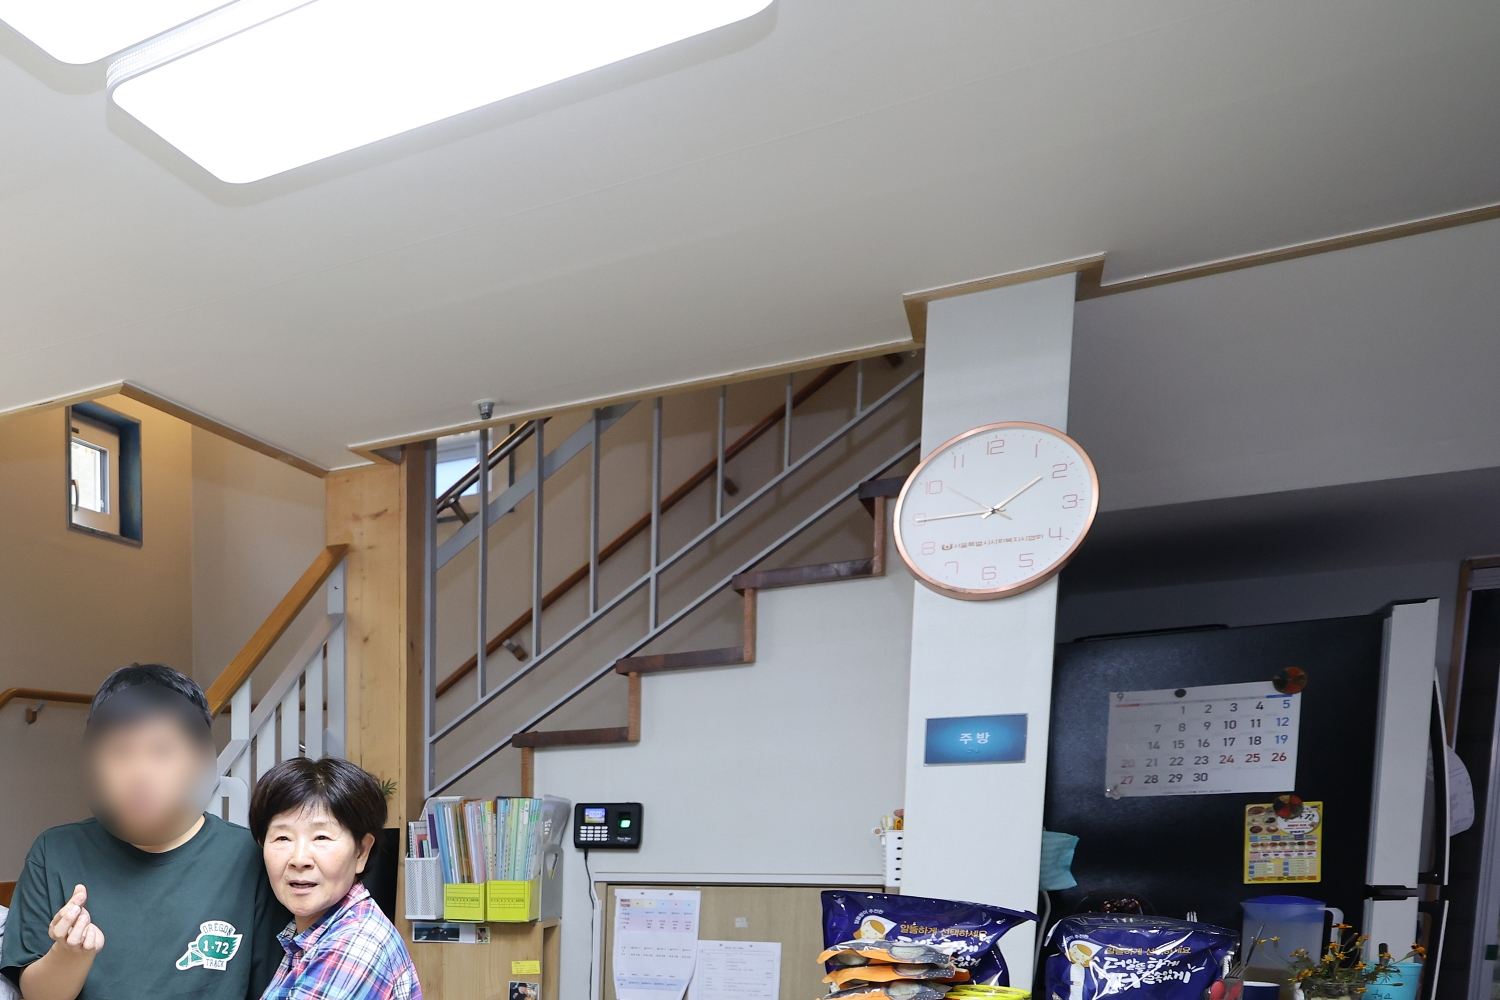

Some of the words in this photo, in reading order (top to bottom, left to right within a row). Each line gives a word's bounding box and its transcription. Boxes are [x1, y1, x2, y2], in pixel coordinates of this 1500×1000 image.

[986, 438, 1006, 456] 12
[1033, 442, 1039, 458] 1
[952, 453, 965, 469] 11
[1052, 463, 1068, 480] 2
[925, 478, 944, 495] 10
[1062, 493, 1078, 510] 3
[1047, 526, 1064, 541] 4
[921, 541, 936, 556] 8
[944, 560, 959, 575] 7
[1018, 552, 1035, 568] 5
[981, 565, 997, 581] 6
[1181, 706, 1185, 715] 1
[1204, 704, 1212, 714] 2
[1230, 703, 1238, 712] 3
[1255, 701, 1264, 710] 4
[1282, 700, 1290, 709] 5
[1154, 724, 1162, 733] 7
[1178, 723, 1186, 732] 8
[1203, 721, 1212, 731] 9
[1223, 720, 1237, 730] 10
[1250, 719, 1261, 728] 11
[1276, 717, 1290, 727] 12
[959, 732, 990, 745] 주방
[1148, 741, 1160, 750] 14
[1173, 740, 1185, 749] 15
[1197, 739, 1210, 748] 16
[1223, 737, 1236, 746] 17
[1248, 736, 1262, 745] 18
[1275, 735, 1288, 744] 19
[1121, 759, 1135, 768] 20
[1145, 758, 1158, 767] 21
[1169, 757, 1184, 766] 22
[1194, 756, 1209, 765] 23
[1219, 755, 1235, 764] 24
[1245, 753, 1260, 763] 25
[1271, 752, 1287, 762] 26
[1120, 776, 1134, 785] 27
[1143, 775, 1159, 784] 28
[1168, 774, 1183, 783] 29
[1193, 773, 1208, 782] 30
[202, 923, 234, 936] OREGON
[205, 958, 225, 968] TRACK
